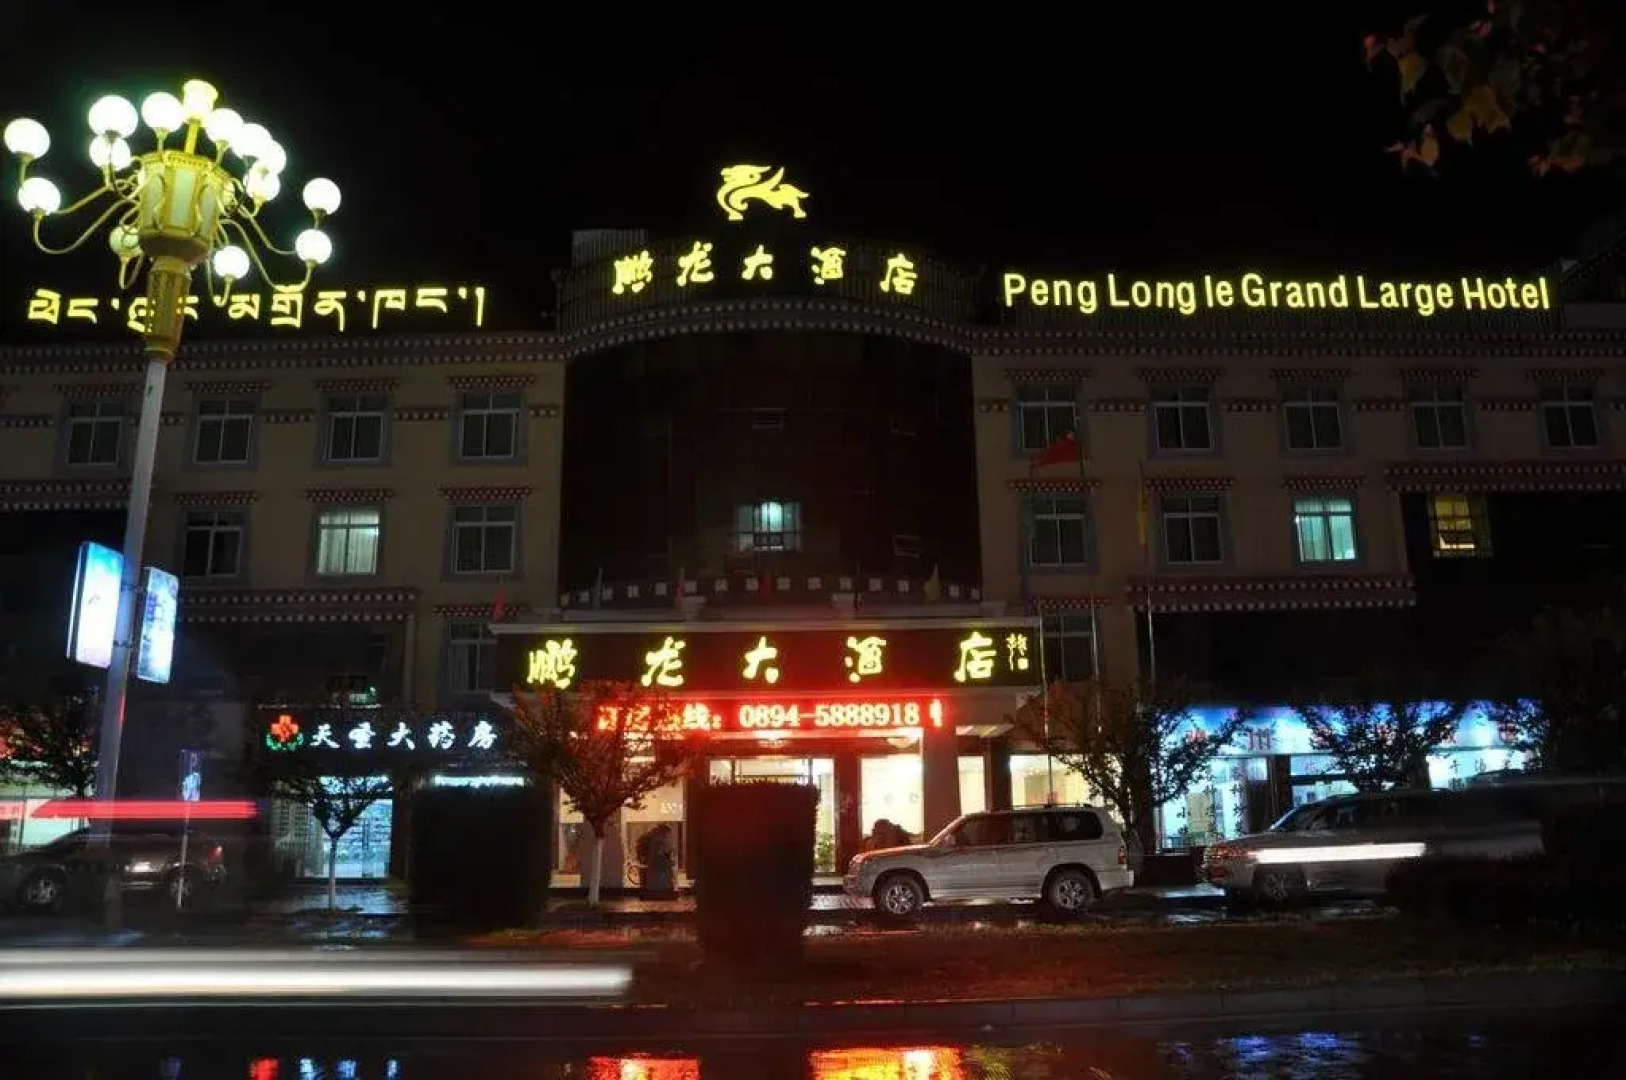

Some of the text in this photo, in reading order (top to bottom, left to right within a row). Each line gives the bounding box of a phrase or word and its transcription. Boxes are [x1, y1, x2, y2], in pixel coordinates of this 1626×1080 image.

[612, 241, 918, 295] 鹏龙大酒店
[1004, 272, 1550, 317] Peng Long le Grand Large Hotel
[526, 631, 997, 689] 鹏龙大酒店
[738, 702, 920, 728] 0894-5888918
